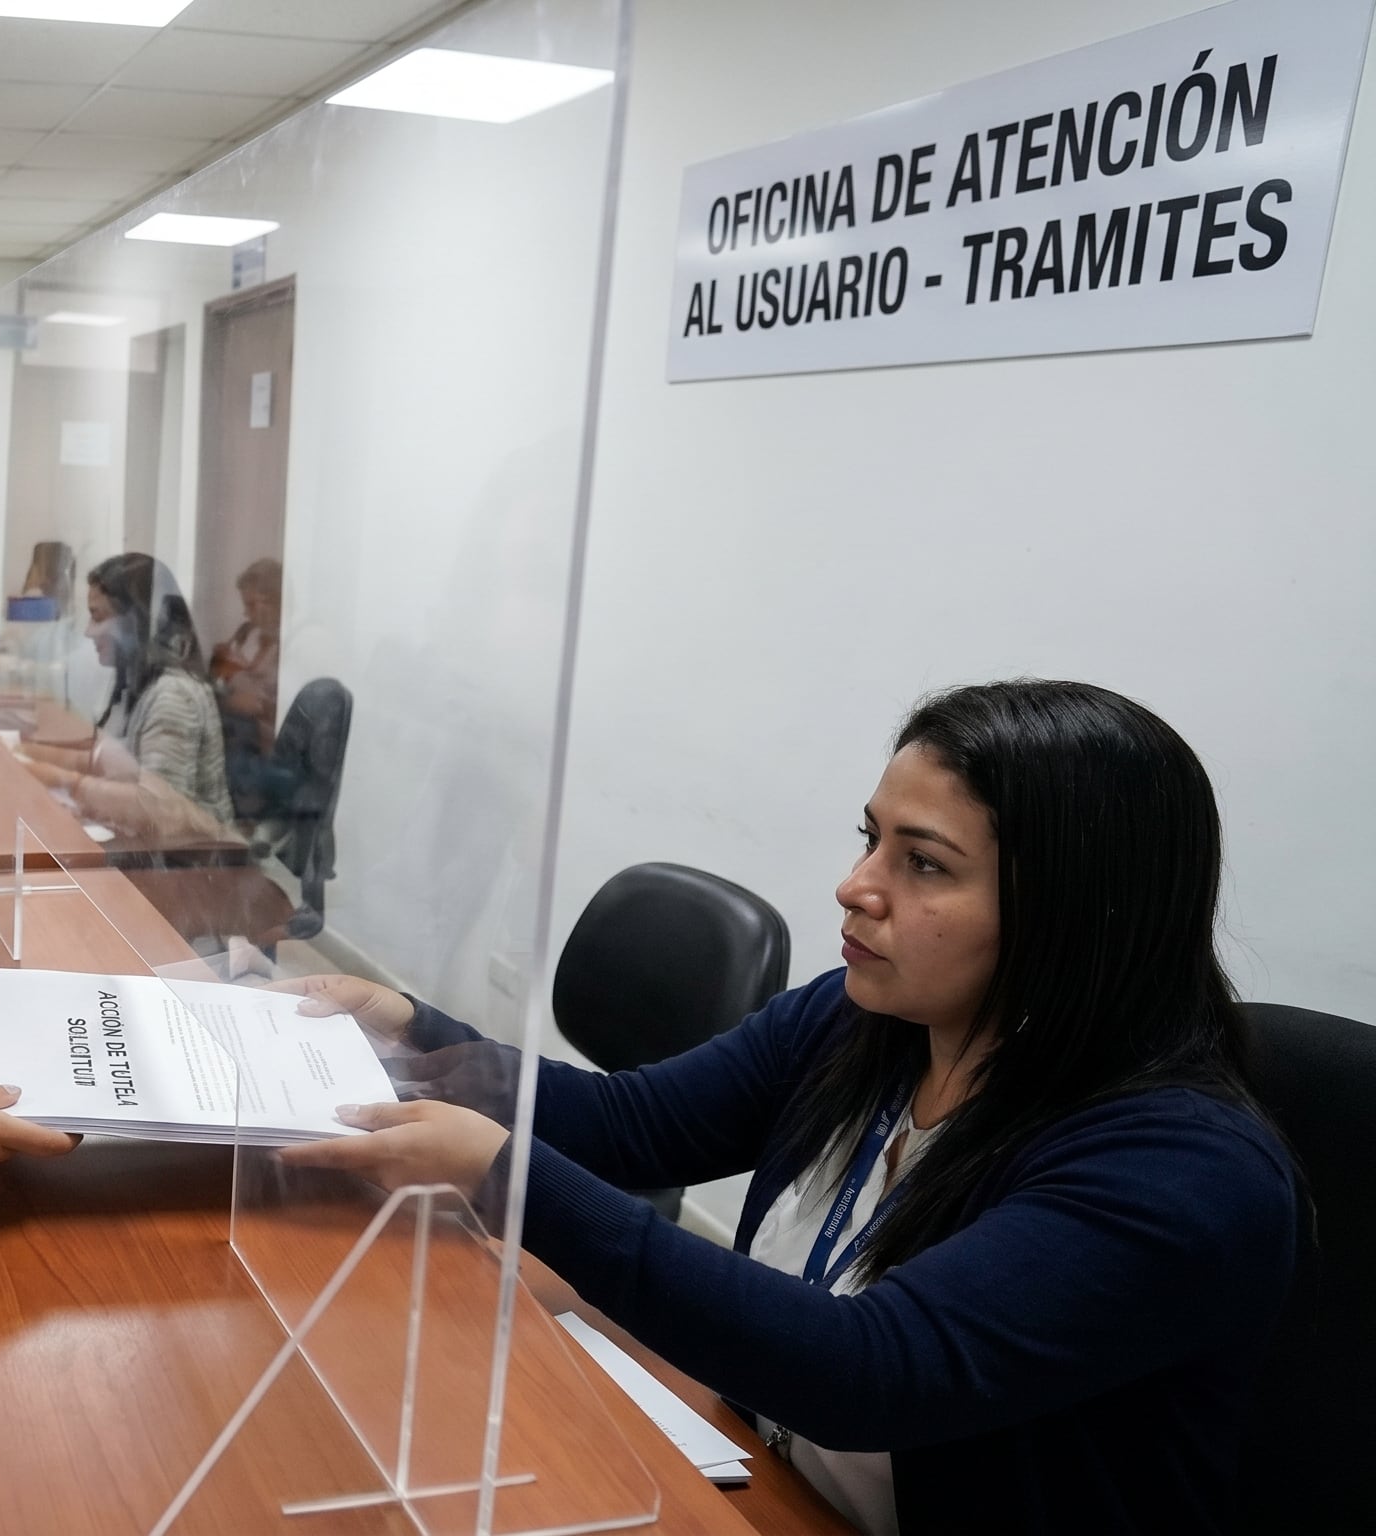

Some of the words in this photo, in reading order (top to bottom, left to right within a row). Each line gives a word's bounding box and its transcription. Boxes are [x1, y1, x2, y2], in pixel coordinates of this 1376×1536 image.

[707, 164, 856, 255] OFICINA
[872, 143, 937, 223] DE
[946, 48, 1278, 208] ATENCIÓN
[683, 279, 723, 338] AL
[736, 246, 909, 332] USUARIO
[925, 274, 942, 288] -
[963, 178, 1293, 305] TRAMITES
[98, 990, 124, 1037] ACCIÓN
[105, 1042, 127, 1057] DE
[109, 1061, 139, 1106] TUTELA
